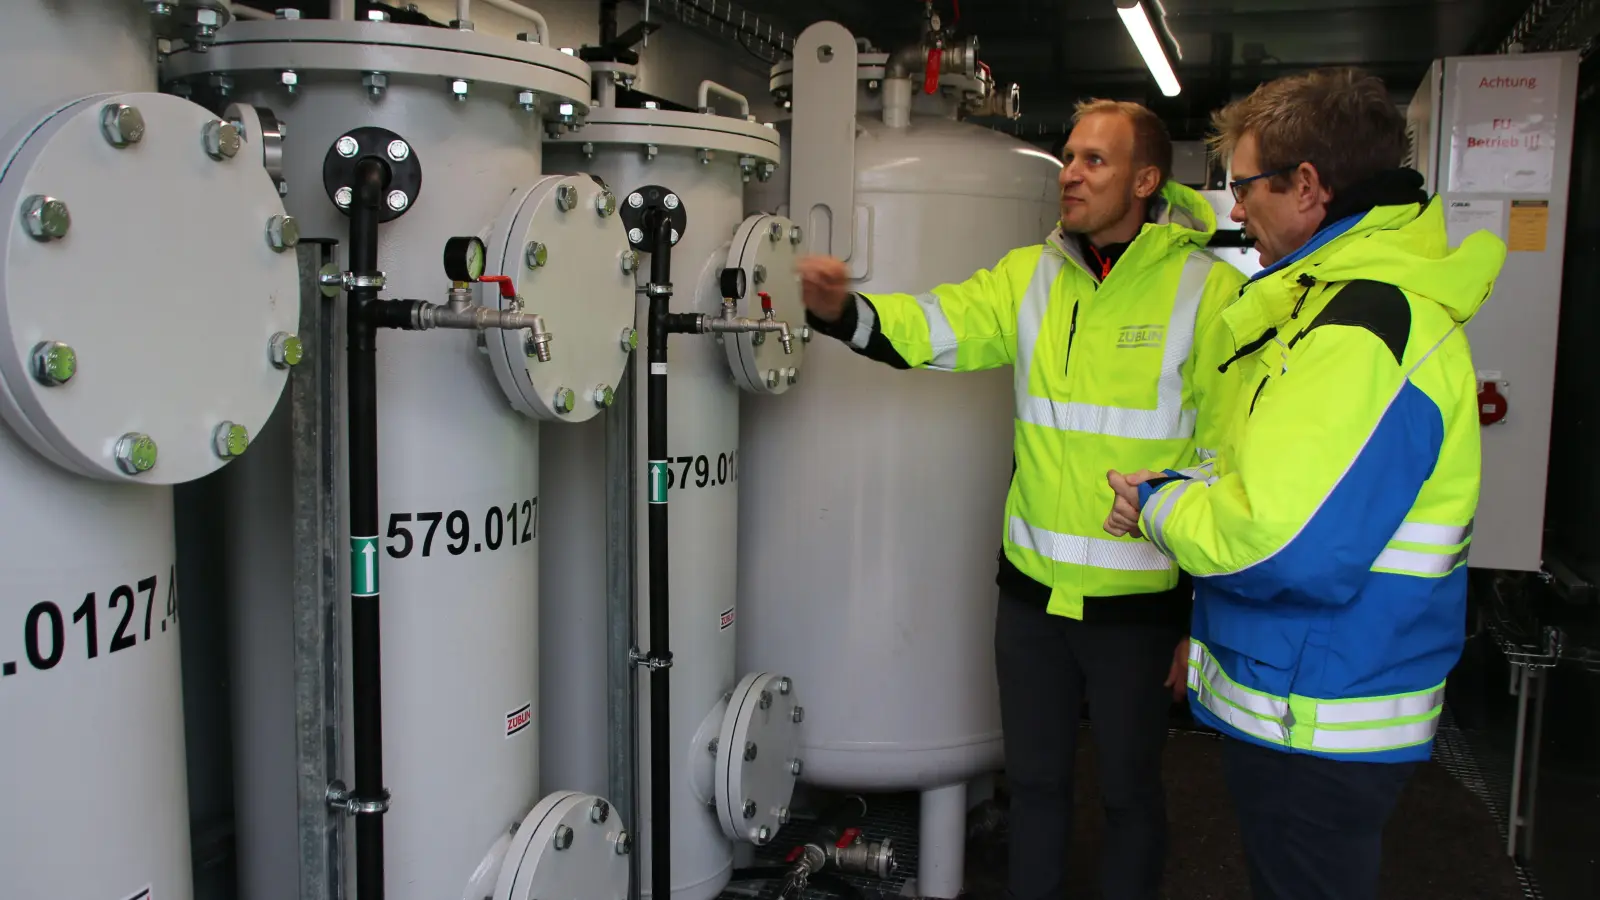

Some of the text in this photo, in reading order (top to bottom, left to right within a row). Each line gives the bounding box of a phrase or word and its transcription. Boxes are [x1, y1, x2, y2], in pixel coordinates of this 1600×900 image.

[1478, 76, 1538, 89] Achtung
[1467, 136, 1519, 148] Betrieb
[385, 495, 538, 559] 579.0127
